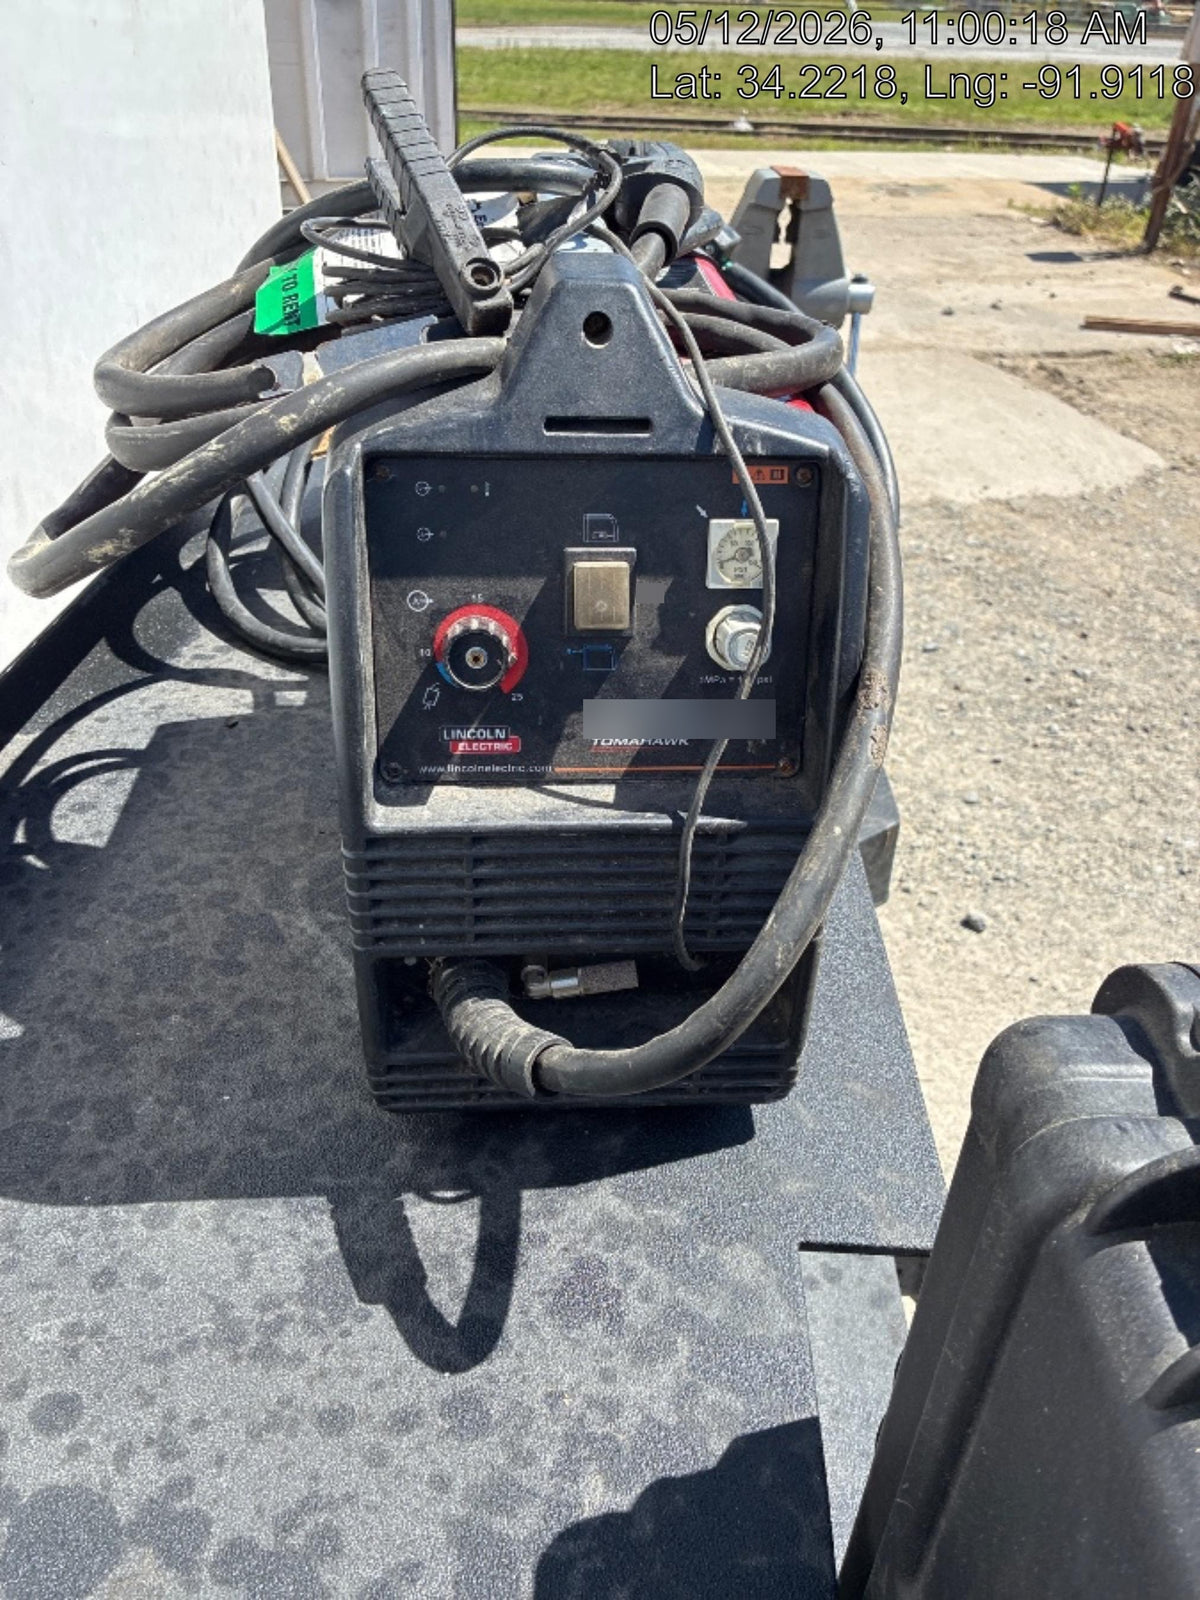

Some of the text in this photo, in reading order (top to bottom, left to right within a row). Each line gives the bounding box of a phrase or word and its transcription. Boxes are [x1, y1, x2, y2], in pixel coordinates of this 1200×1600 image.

[282, 272, 298, 292] TO
[282, 293, 301, 326] RENT
[420, 648, 431, 657] 10
[511, 692, 524, 701] 25
[443, 728, 508, 741] LINCOLN
[457, 741, 514, 751] ELECTRIC
[591, 738, 690, 747] TOMAHAWK
[418, 763, 553, 774] www.lincolnelectric.com
